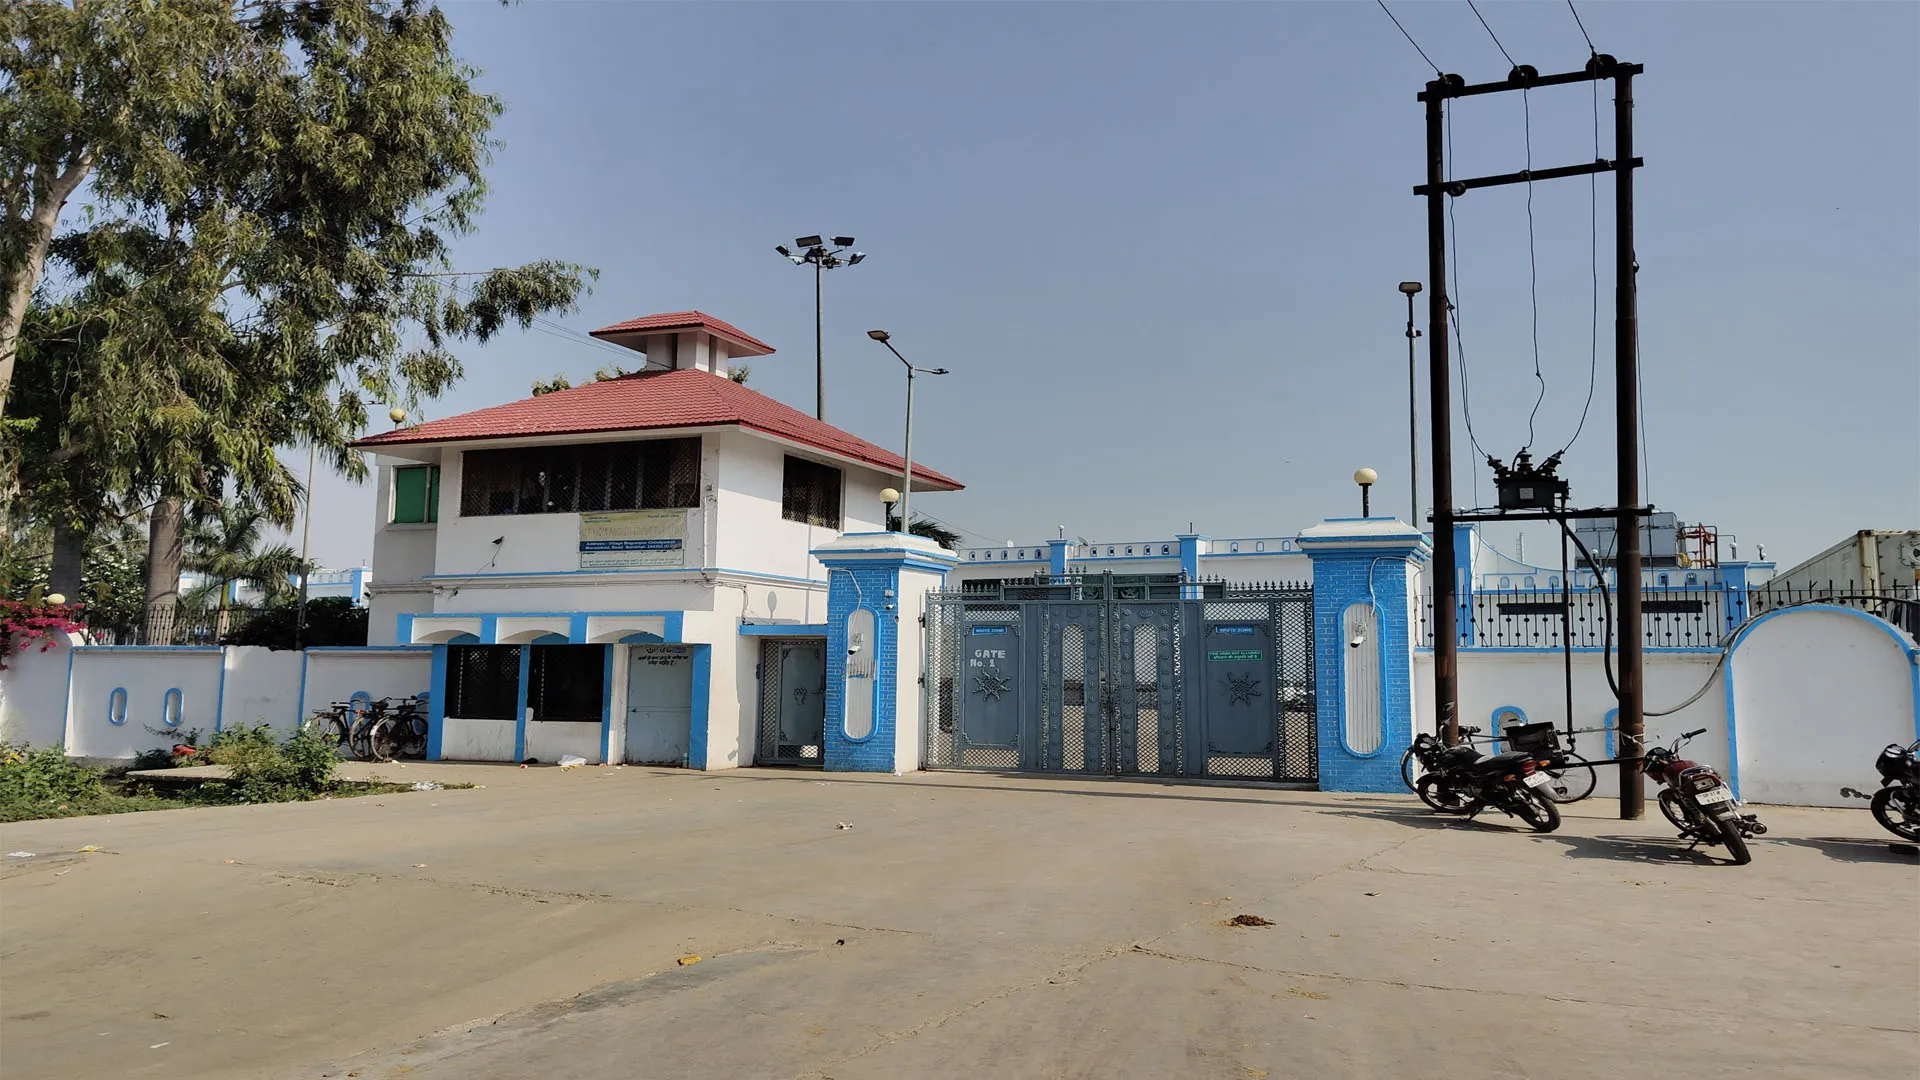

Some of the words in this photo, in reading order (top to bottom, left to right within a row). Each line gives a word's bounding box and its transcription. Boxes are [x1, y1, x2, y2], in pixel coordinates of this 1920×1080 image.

[975, 649, 1006, 659] GATE
[969, 658, 986, 668] No.
[989, 658, 996, 668] 1
